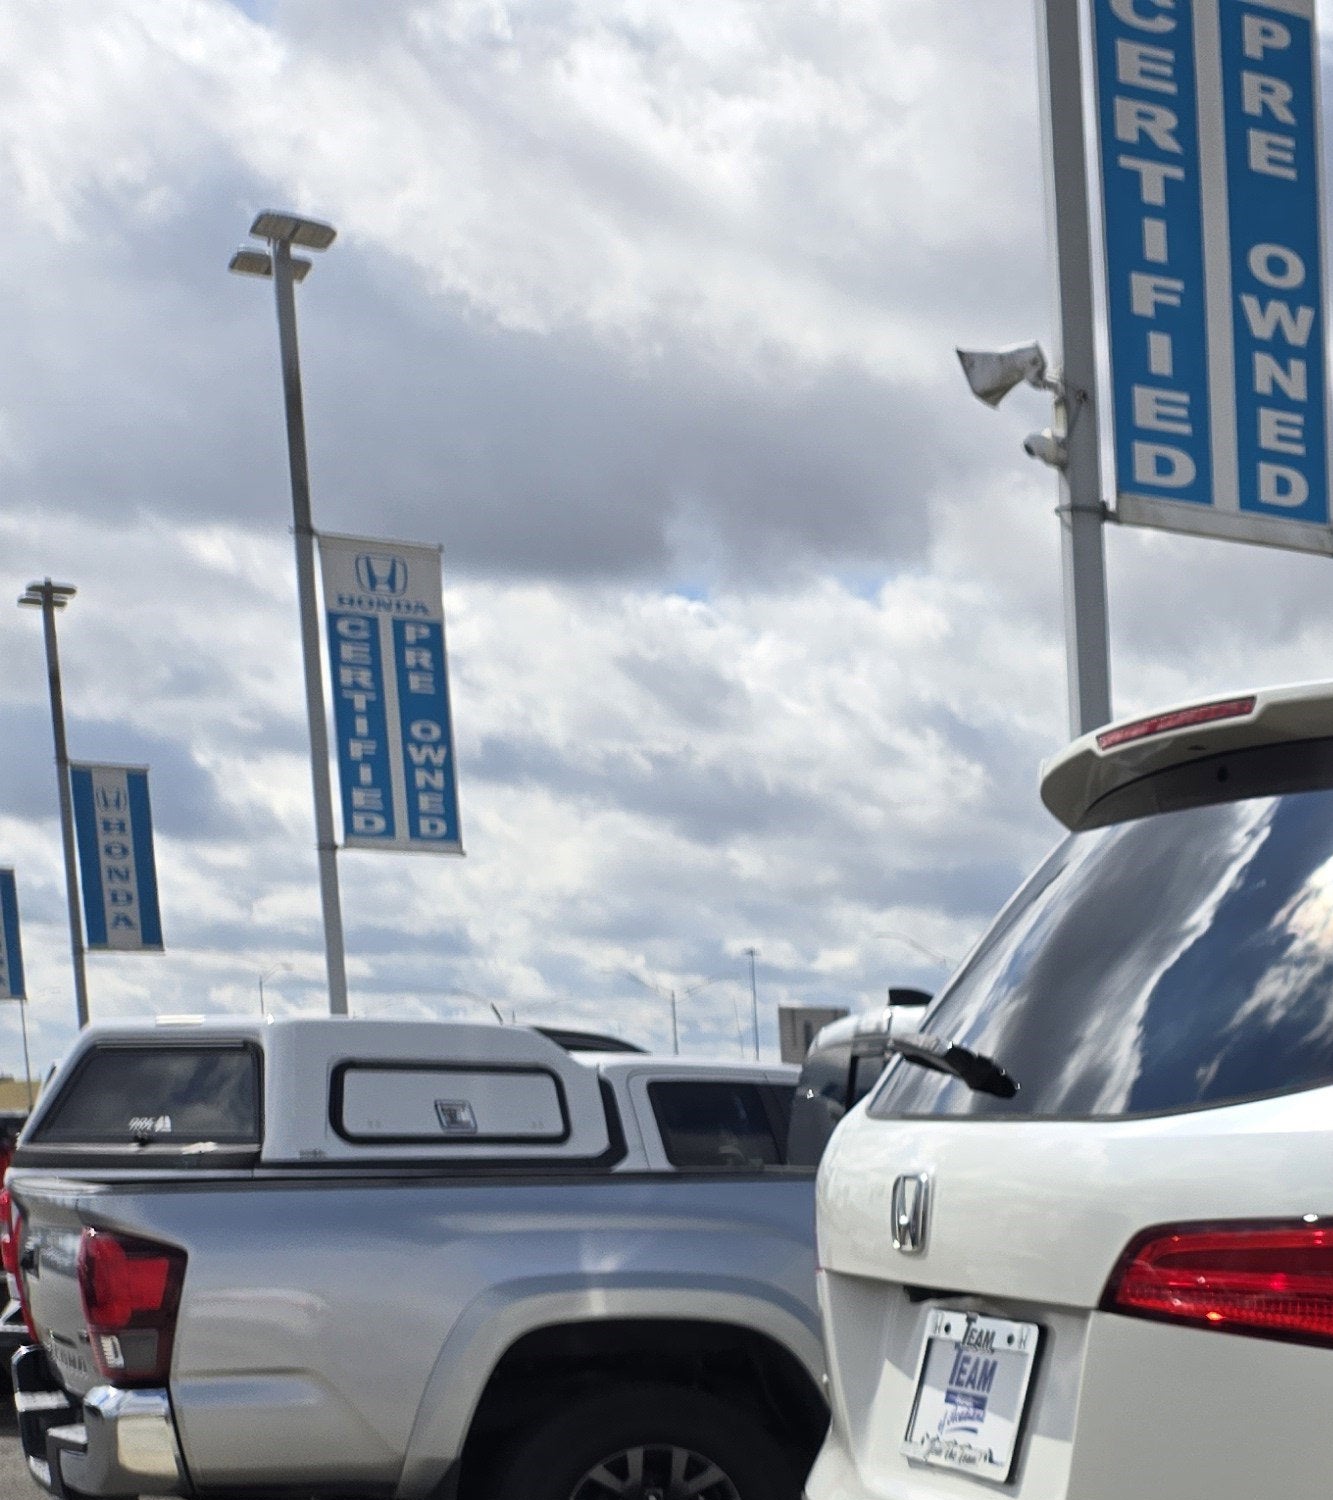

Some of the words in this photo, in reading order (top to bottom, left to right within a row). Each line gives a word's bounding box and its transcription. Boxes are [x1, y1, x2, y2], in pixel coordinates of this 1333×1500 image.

[1240, 13, 1298, 182] PRE
[1239, 243, 1316, 509] OWNED
[336, 592, 431, 616] HONDA
[404, 622, 435, 695] PRE
[336, 615, 387, 836] CERTIFIED
[407, 718, 448, 839] OWNED
[101, 817, 135, 930] HONDA
[948, 1342, 999, 1393] TEAM
[962, 1316, 997, 1350] TEAM
